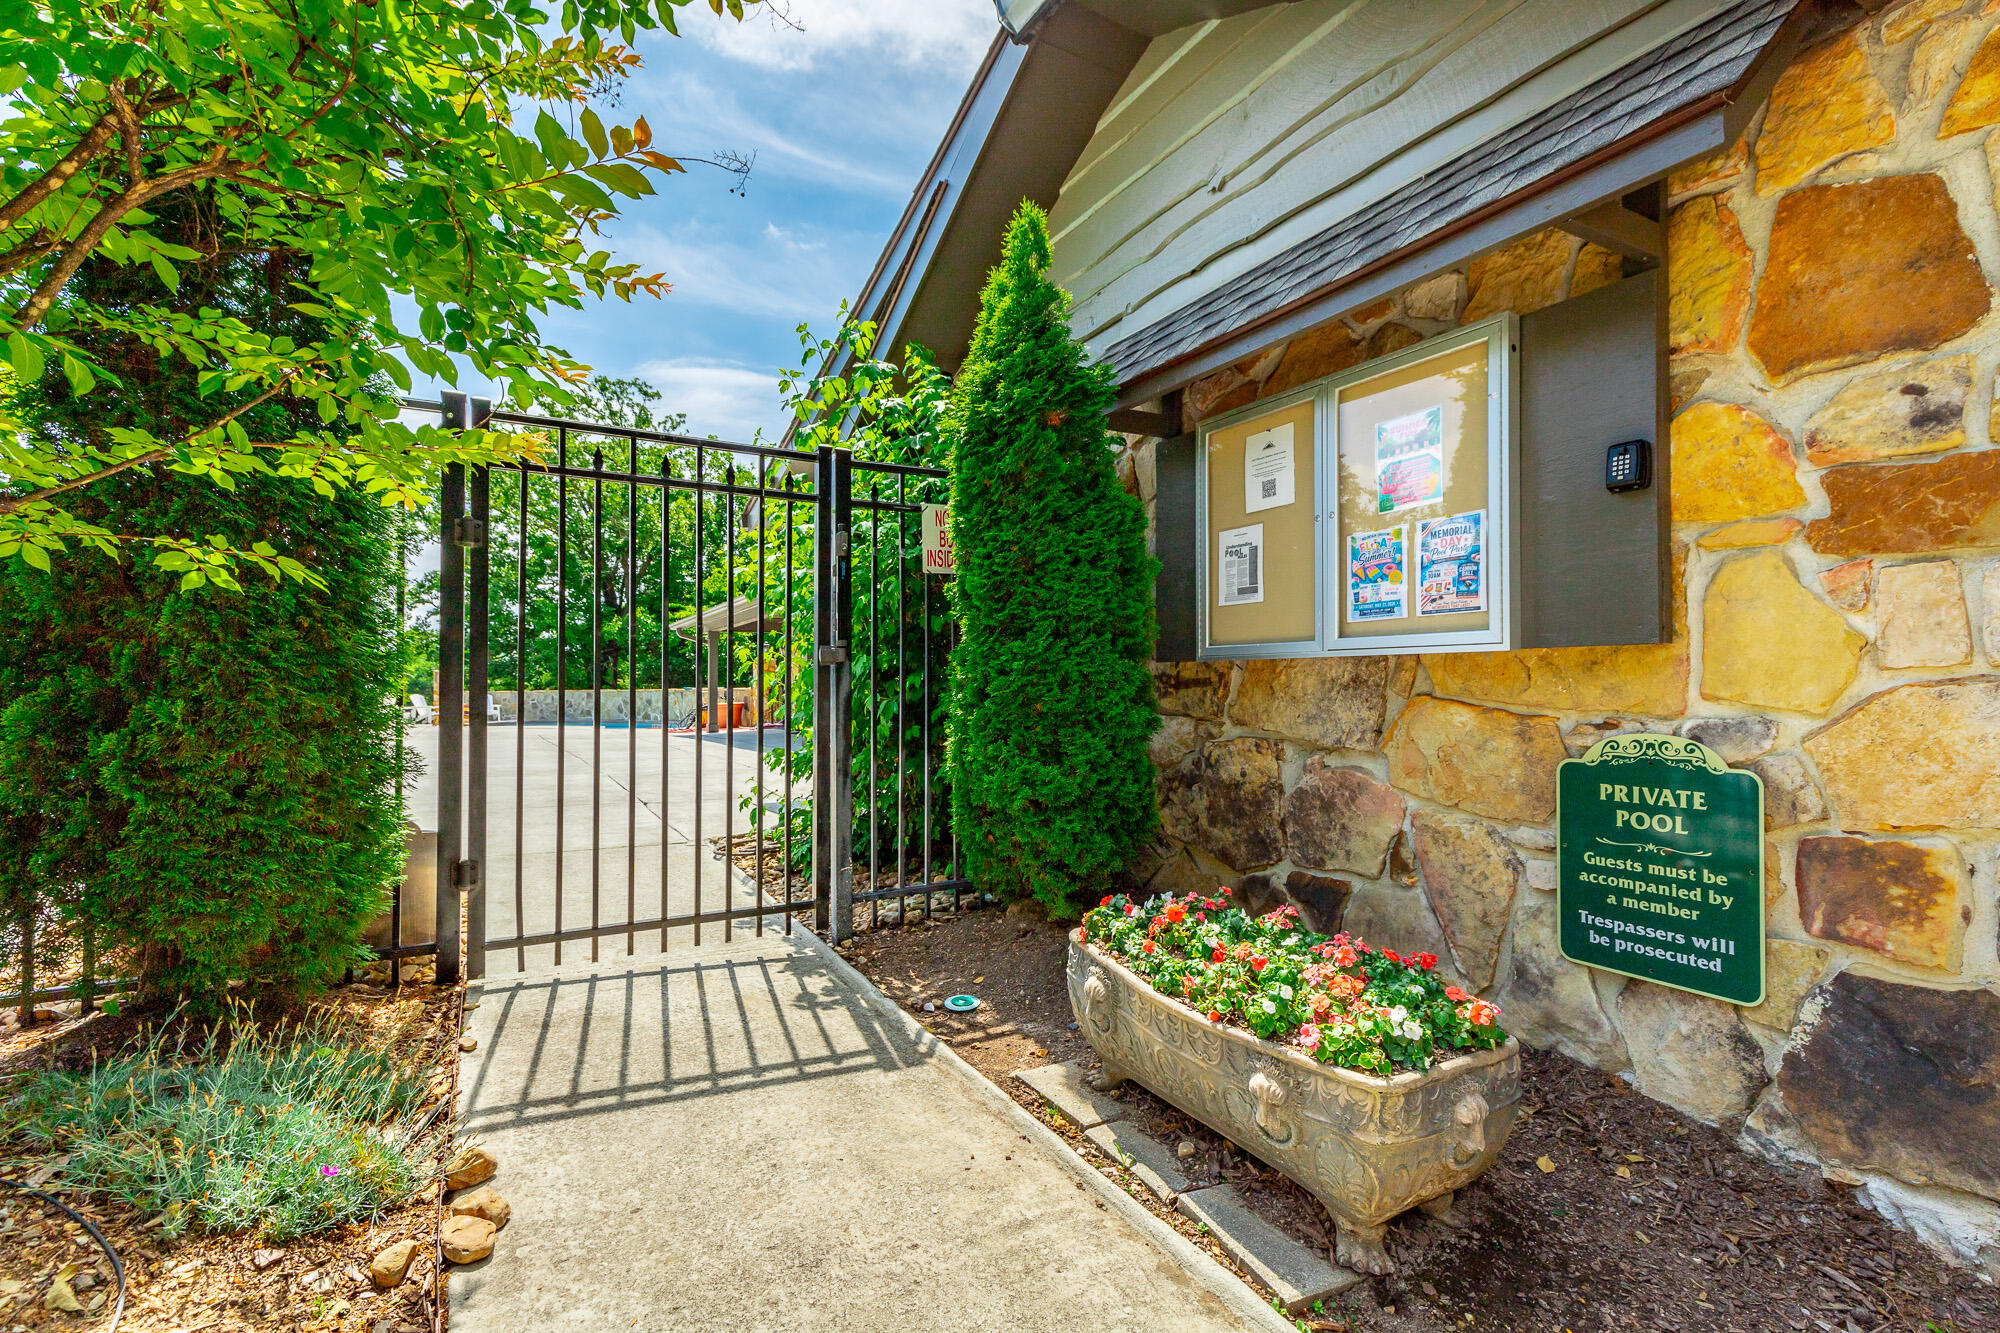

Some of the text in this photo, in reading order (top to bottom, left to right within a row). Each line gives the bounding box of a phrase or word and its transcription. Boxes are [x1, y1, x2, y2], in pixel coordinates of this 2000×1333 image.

[1430, 525, 1473, 540] MEMORIAL
[1440, 535, 1463, 548] DAY
[926, 549, 957, 568] INSID
[1600, 783, 1708, 811] PRIVATE
[1616, 809, 1689, 835] POOL
[1583, 851, 1728, 886] Guests must be
[1579, 869, 1734, 910] accompanied by
[1606, 892, 1700, 921] a member
[1578, 909, 1736, 956] Trespassers will
[1589, 929, 1722, 973] be prosecuted
